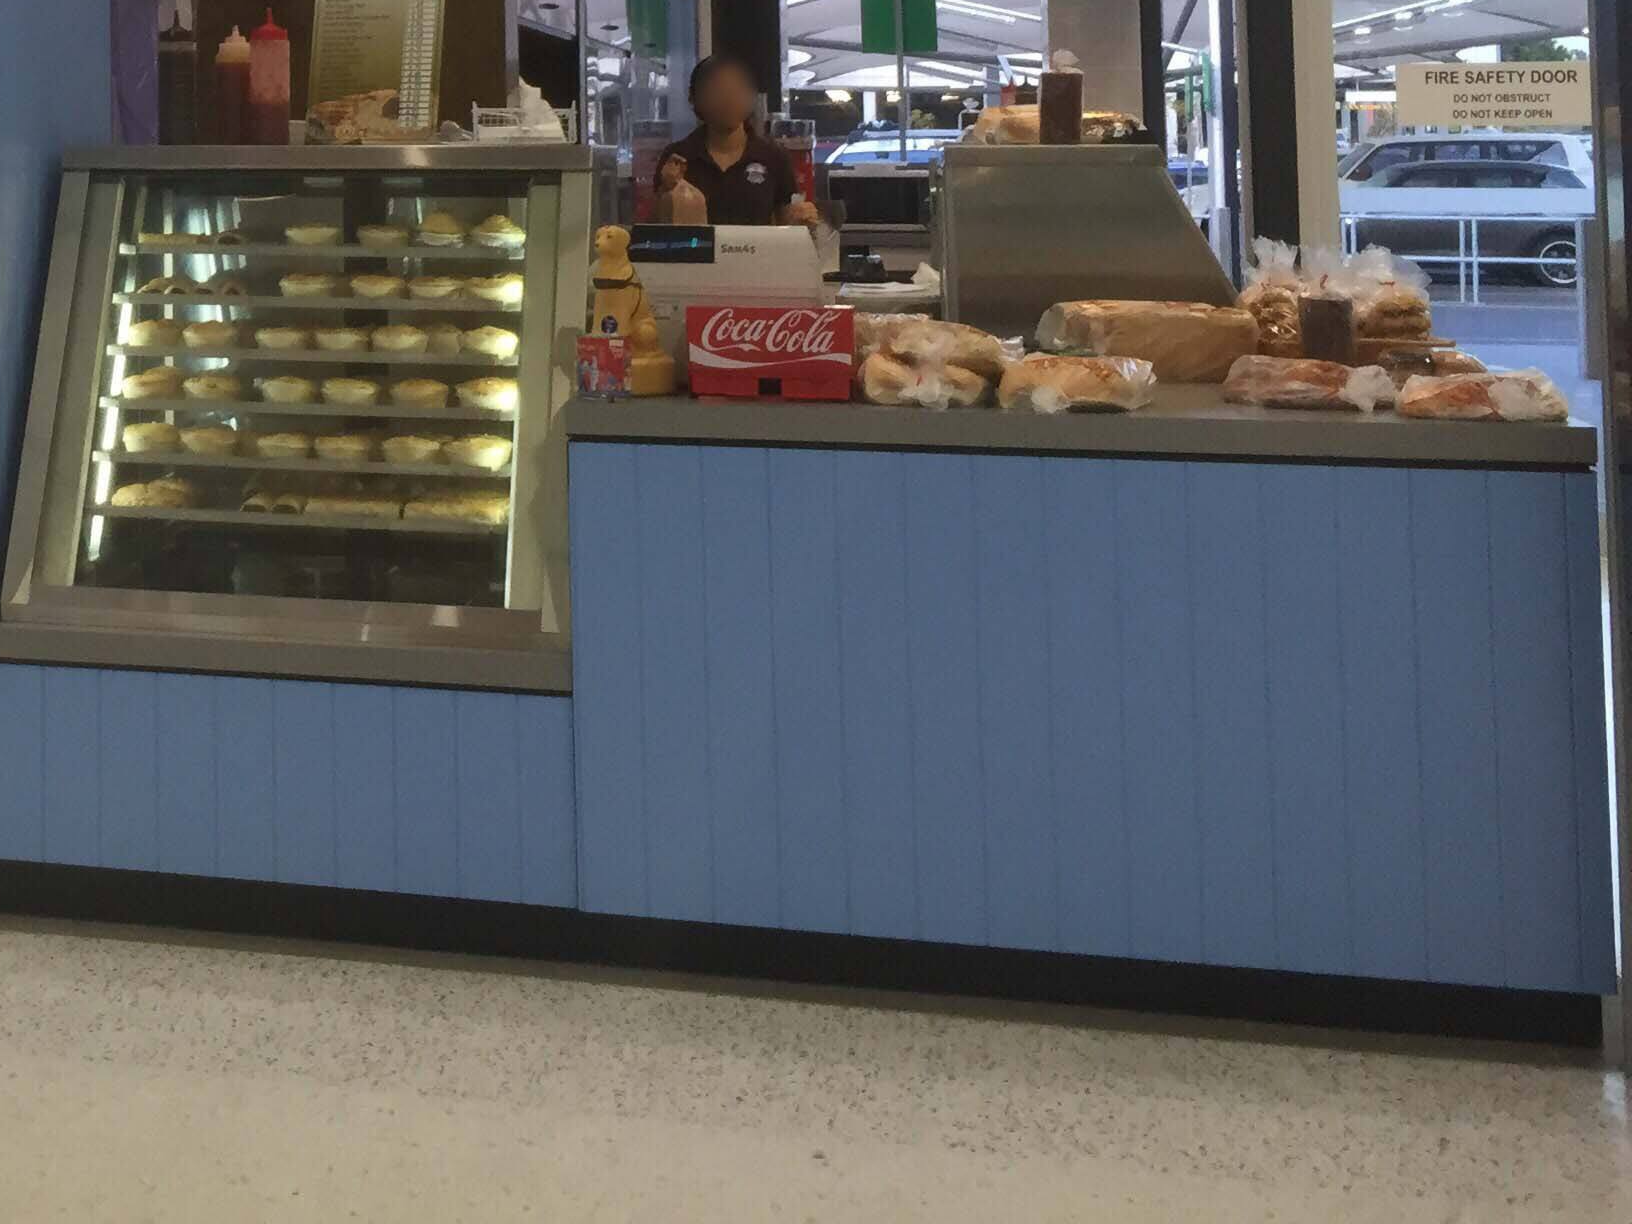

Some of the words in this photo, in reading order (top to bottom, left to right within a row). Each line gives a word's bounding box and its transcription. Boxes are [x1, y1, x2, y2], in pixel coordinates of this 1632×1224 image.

[1425, 70, 1460, 85] FIRE
[1464, 70, 1526, 84] SAFETY
[1530, 69, 1578, 84] DOOR
[1453, 93, 1468, 104] DO
[1471, 93, 1492, 103] NOT
[1494, 93, 1552, 103] OBSTRUCT
[1452, 109, 1468, 119] DO
[1470, 109, 1491, 119] NOT
[1494, 109, 1522, 119] KEEP
[1524, 109, 1553, 119] OPEN
